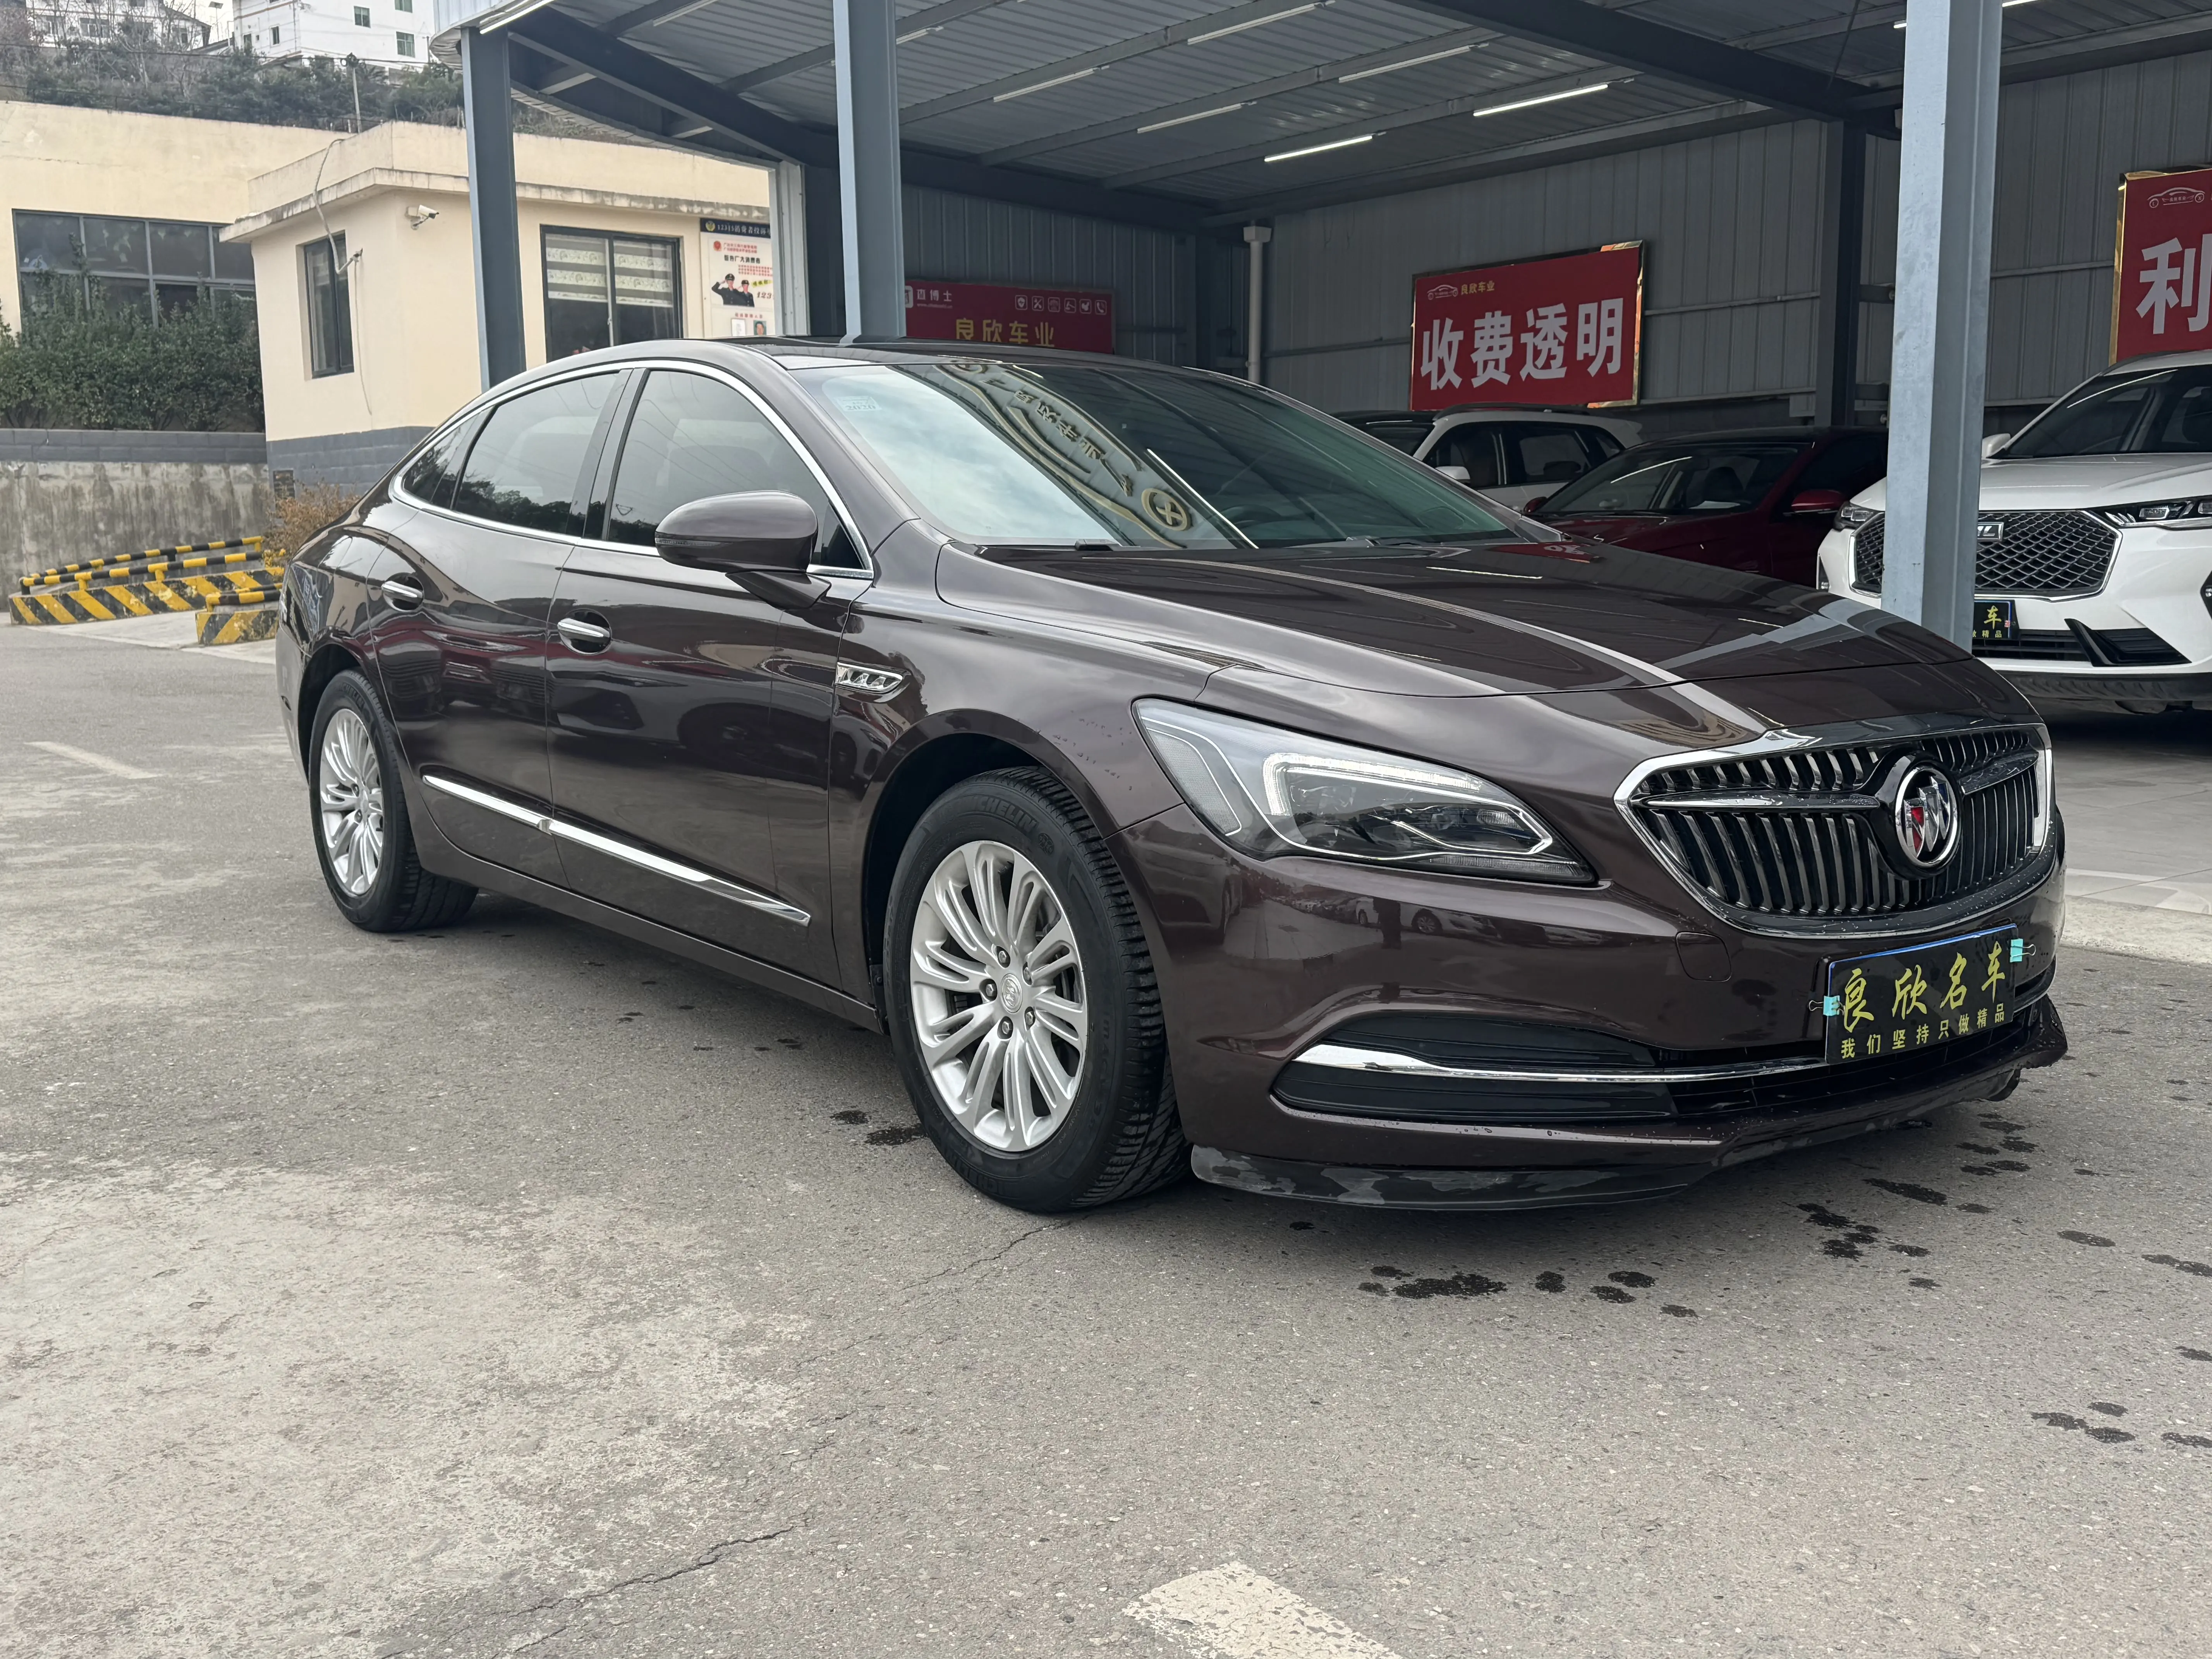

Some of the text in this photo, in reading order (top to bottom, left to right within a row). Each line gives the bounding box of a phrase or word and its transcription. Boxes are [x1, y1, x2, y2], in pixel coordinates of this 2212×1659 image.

[1461, 280, 1495, 295] 良欣车业
[2136, 234, 2212, 334] 利
[956, 318, 1055, 347] 良欣车业
[1420, 297, 1624, 390] 收费透明
[1984, 605, 2002, 630] 车
[1843, 941, 2006, 1033] 良欣名车
[1841, 1003, 2005, 1059] 我们坚持只做精品
